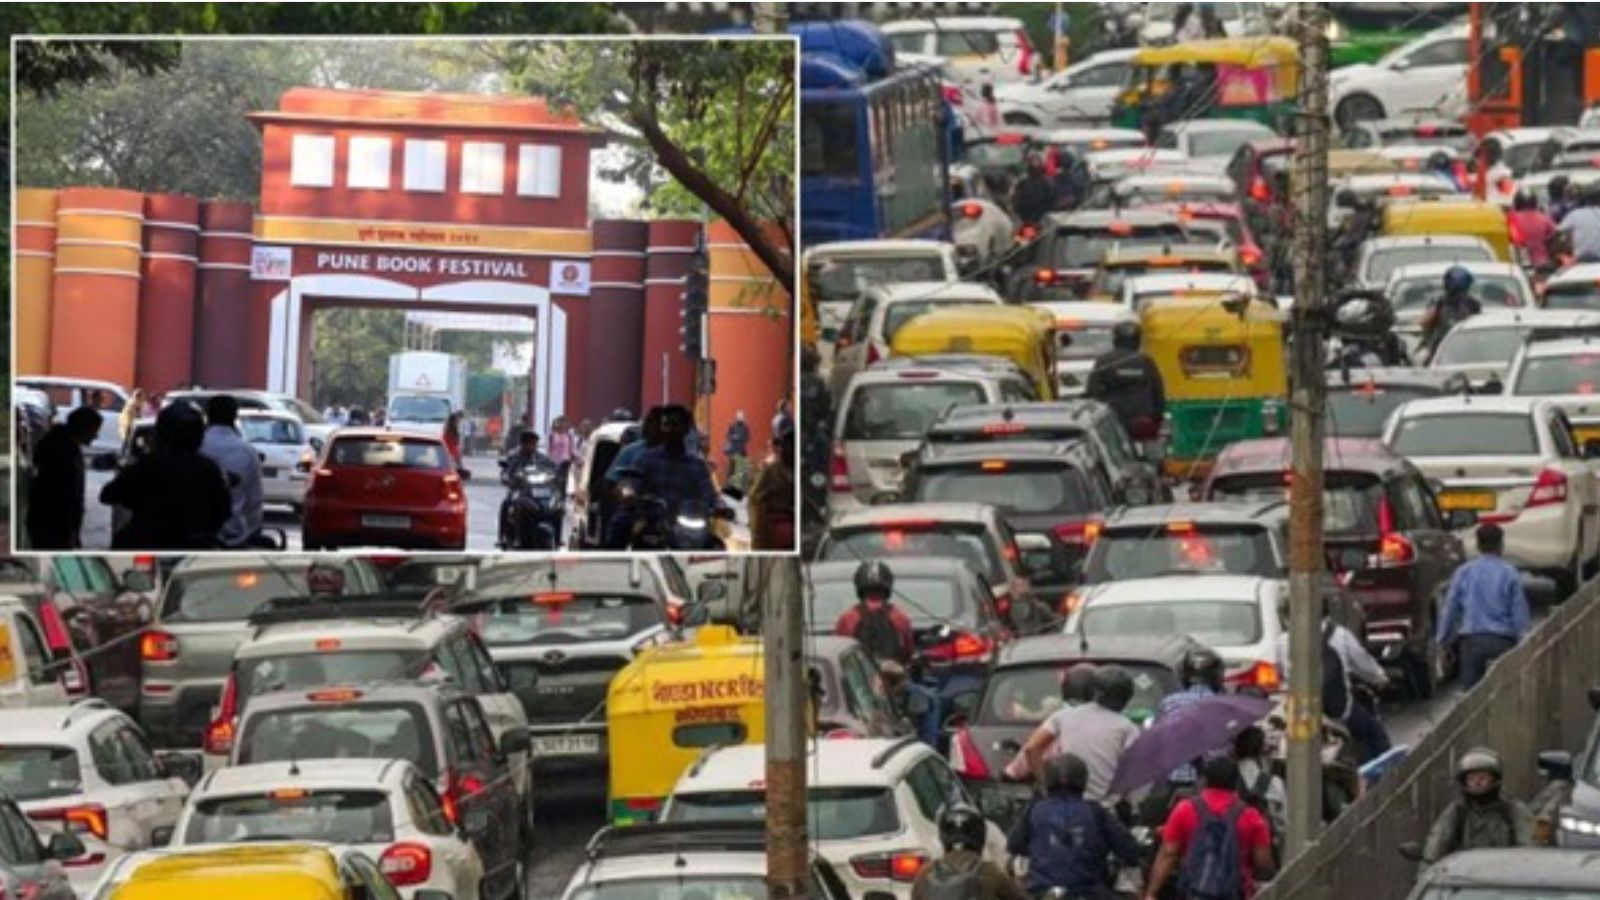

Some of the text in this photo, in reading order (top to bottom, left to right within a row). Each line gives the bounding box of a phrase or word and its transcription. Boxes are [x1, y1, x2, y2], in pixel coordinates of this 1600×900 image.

[317, 252, 527, 277] PUNE BOOK FESTIVAL
[700, 678, 740, 699] NCR
